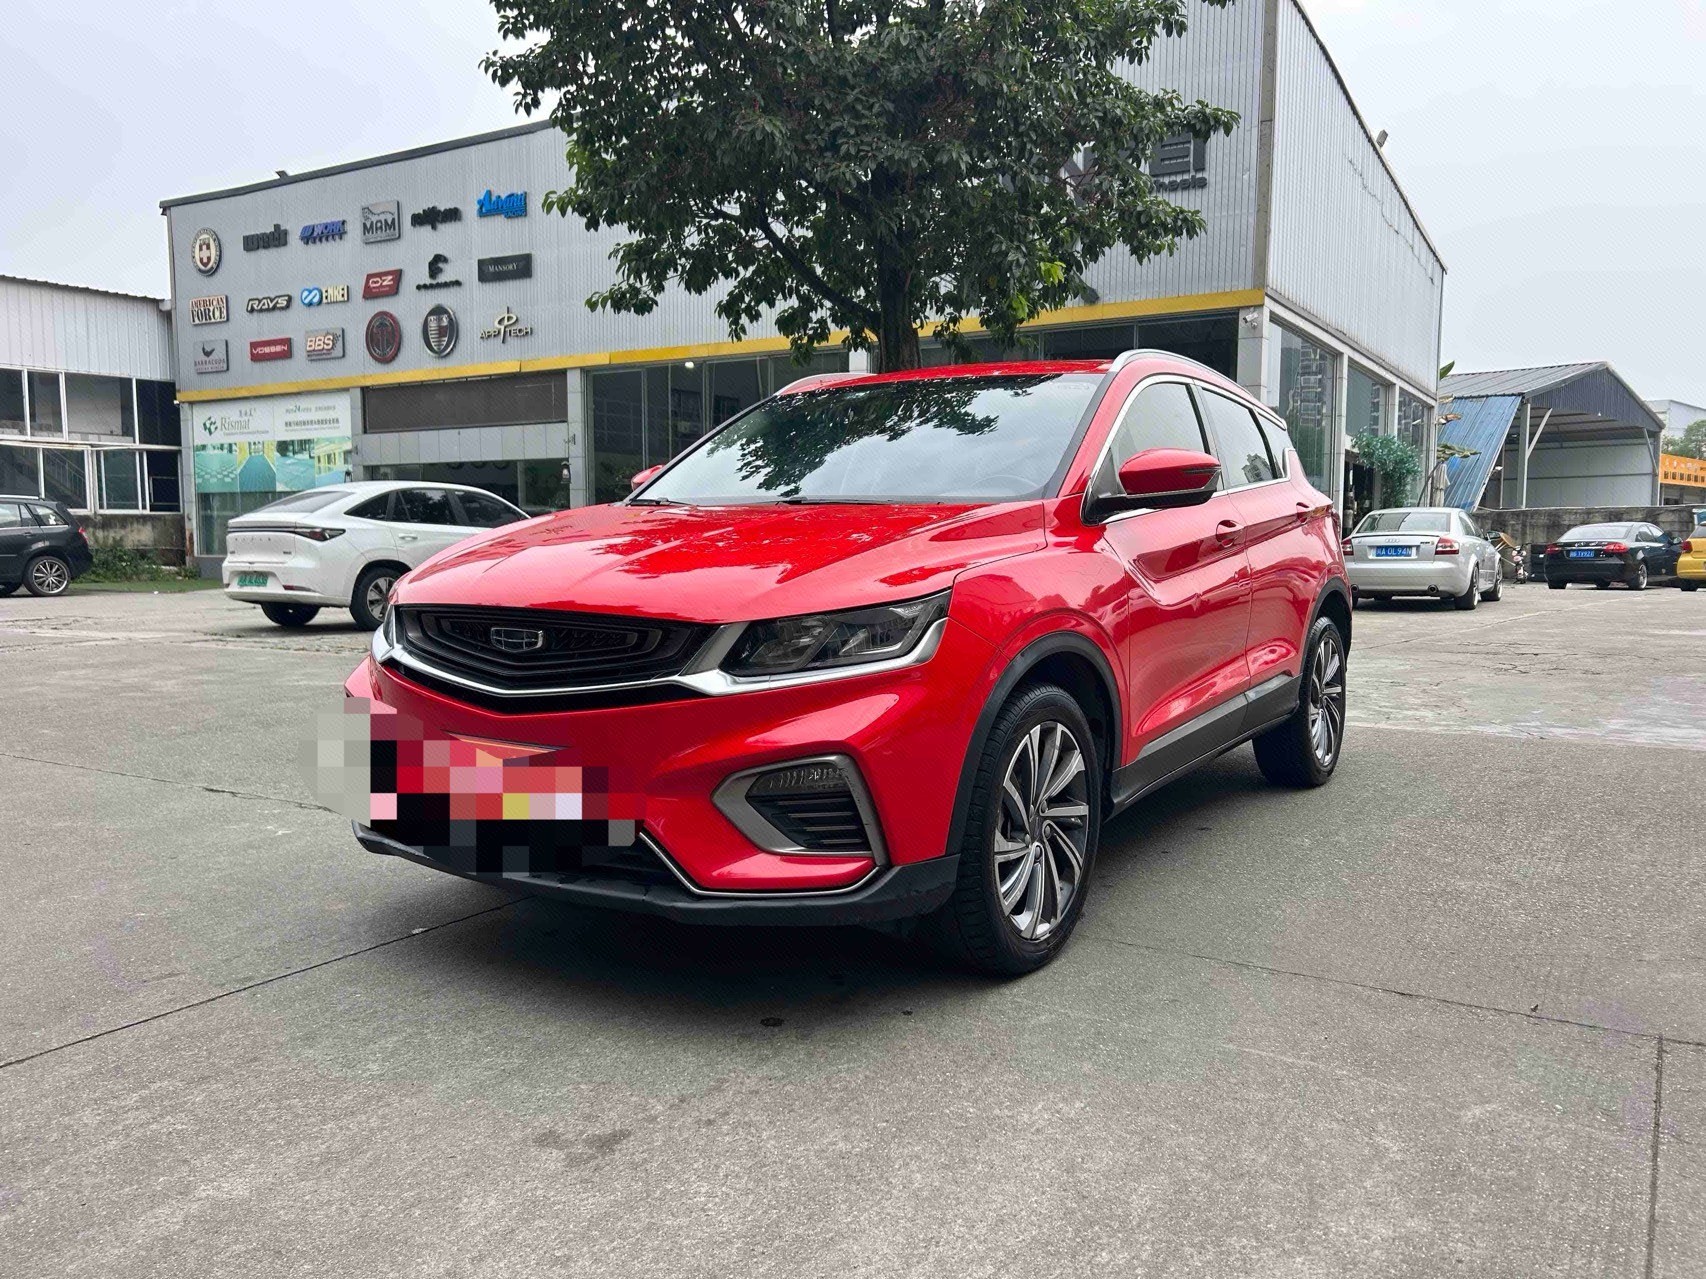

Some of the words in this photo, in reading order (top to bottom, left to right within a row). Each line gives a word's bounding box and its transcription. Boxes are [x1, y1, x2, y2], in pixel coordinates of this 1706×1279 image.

[362, 217, 396, 236] MAM
[488, 262, 518, 273] MANSORY
[190, 296, 225, 309] AMERICAN
[321, 285, 349, 304] ENKEI
[247, 296, 289, 312] RAYS
[191, 305, 226, 323] FORCE
[252, 344, 288, 354] VOSSEN
[306, 335, 333, 351] BBS
